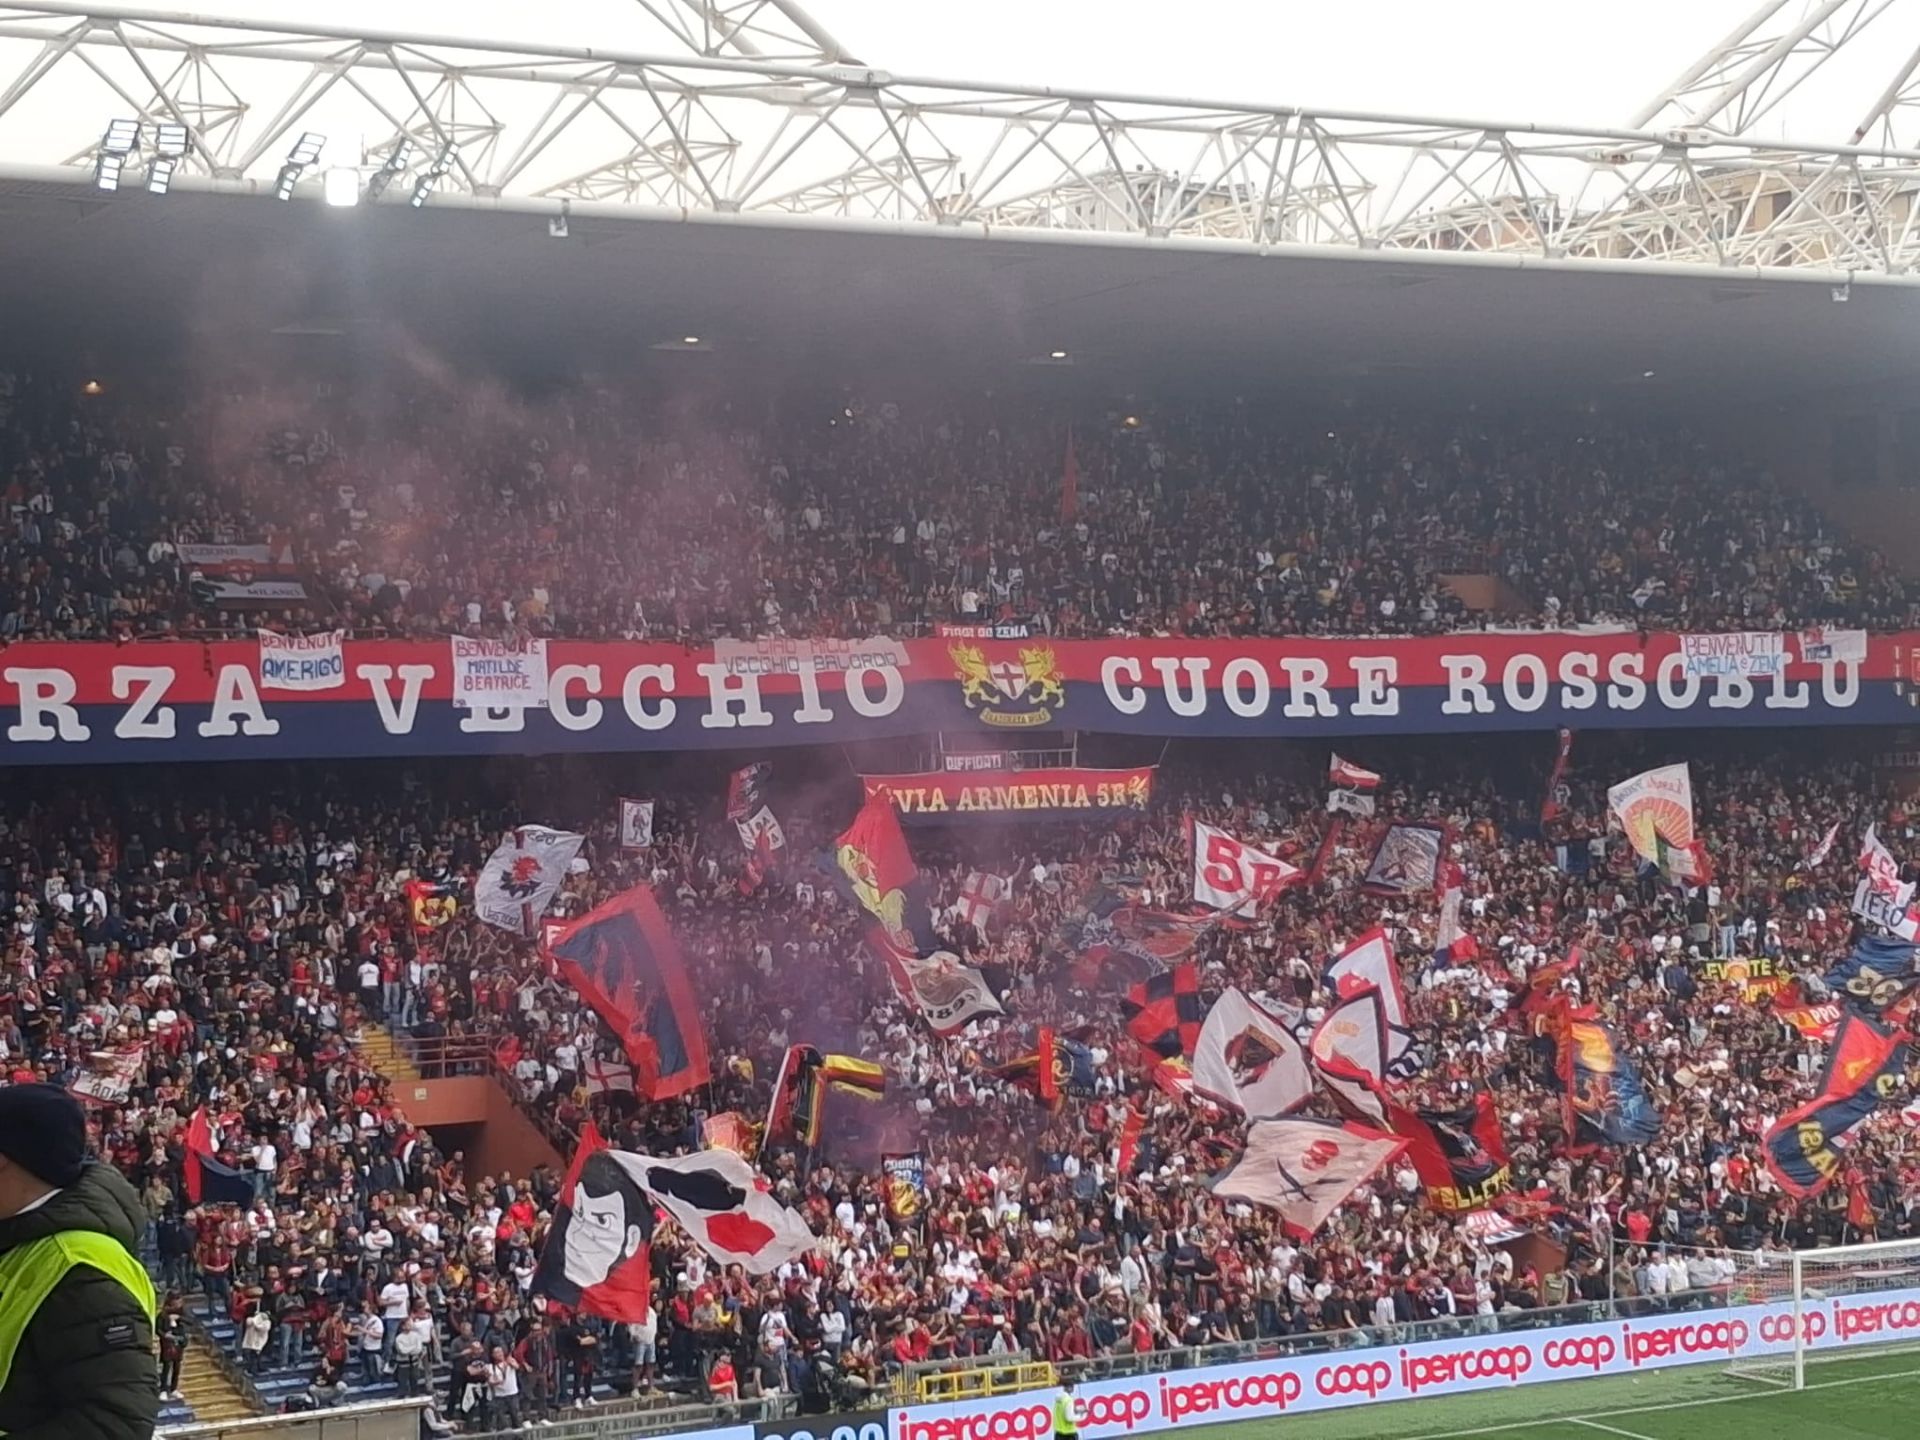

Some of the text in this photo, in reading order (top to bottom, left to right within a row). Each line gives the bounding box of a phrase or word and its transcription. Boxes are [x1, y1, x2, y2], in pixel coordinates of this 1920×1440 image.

[262, 655, 342, 680] AMERIGO
[467, 659, 524, 675] MATILDE
[723, 653, 898, 673] VECCHIO BALORDO
[1687, 655, 1740, 674] AMELIA
[463, 674, 532, 691] BEATRICE
[1101, 655, 1401, 718] CUORE
[1440, 652, 1861, 714] ROSSOBLU
[893, 787, 949, 813] VIA
[955, 783, 1092, 812] ARMENIA
[1159, 1376, 1301, 1423] ipercoop
[1315, 1360, 1391, 1398] coop
[1399, 1348, 1532, 1393] ipercoop
[1543, 1335, 1615, 1371] coop
[1622, 1323, 1749, 1366] ipercoop
[1759, 1310, 1826, 1345] coop
